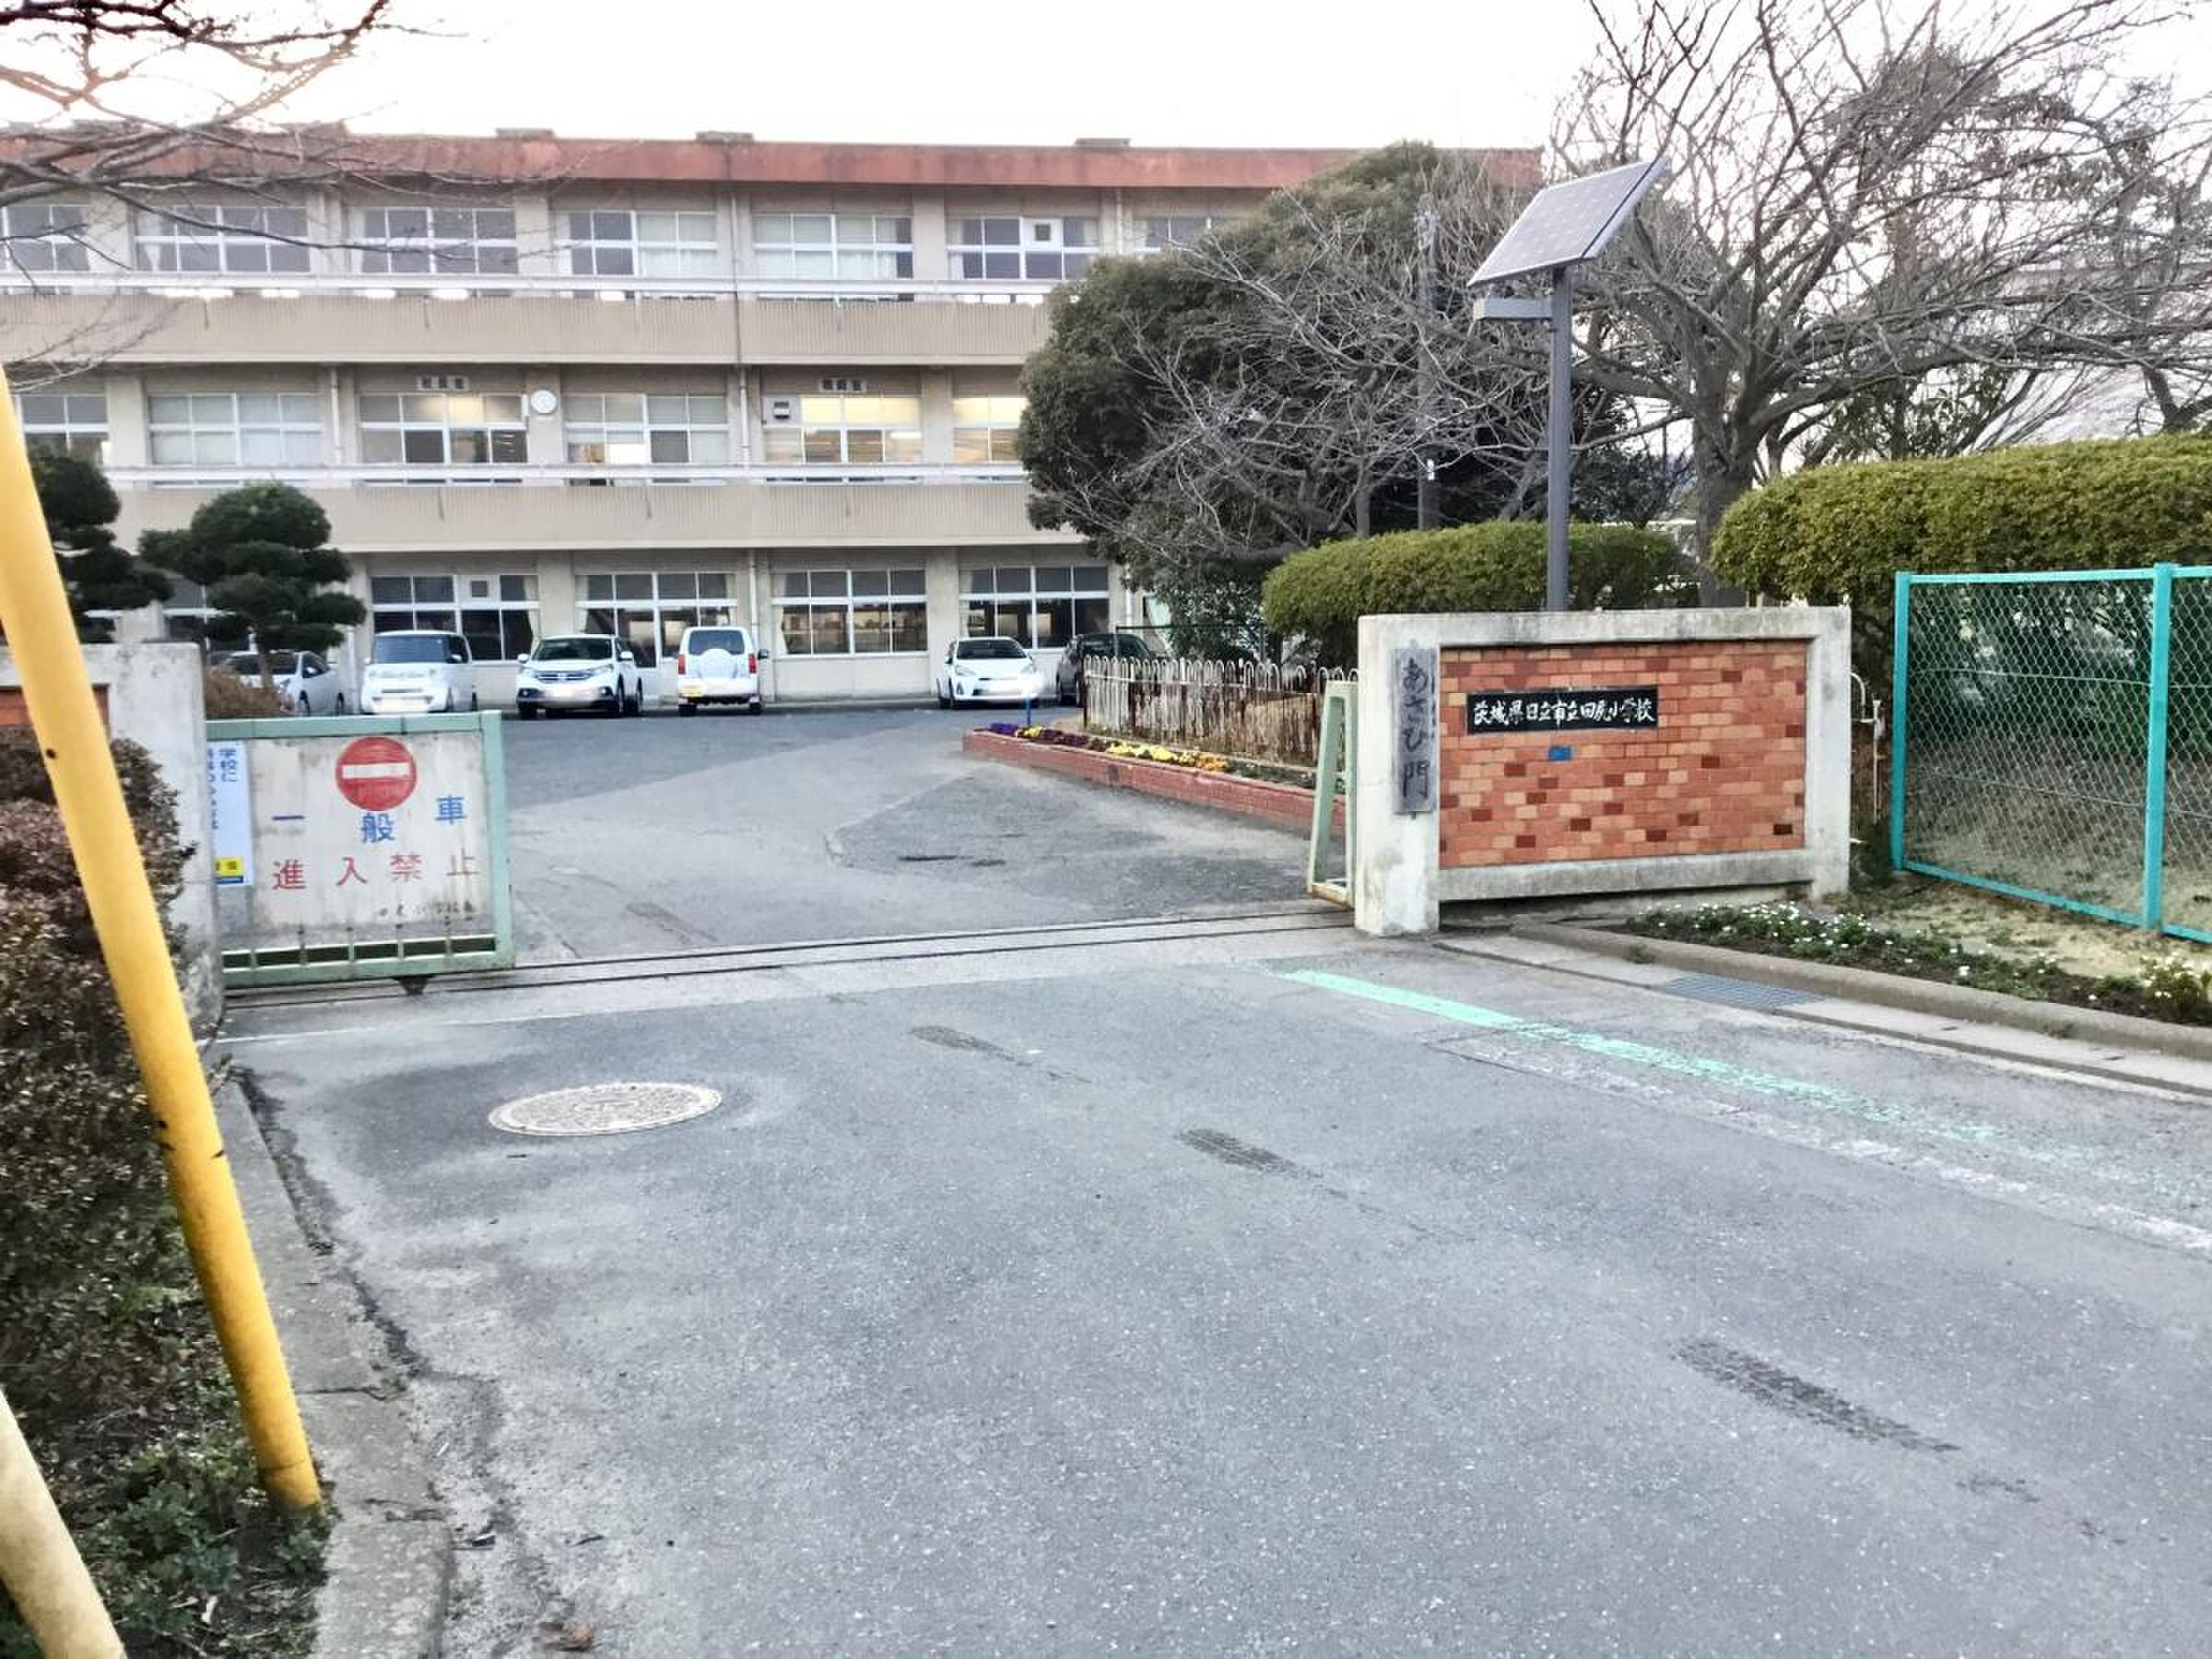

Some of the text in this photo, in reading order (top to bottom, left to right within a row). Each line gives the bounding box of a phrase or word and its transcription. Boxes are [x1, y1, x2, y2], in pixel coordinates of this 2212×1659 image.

[1400, 656, 1430, 800] あさひ門
[1473, 697, 1656, 726] 茨城県日立市立田尻小学校
[272, 848, 480, 891] 進入禁止
